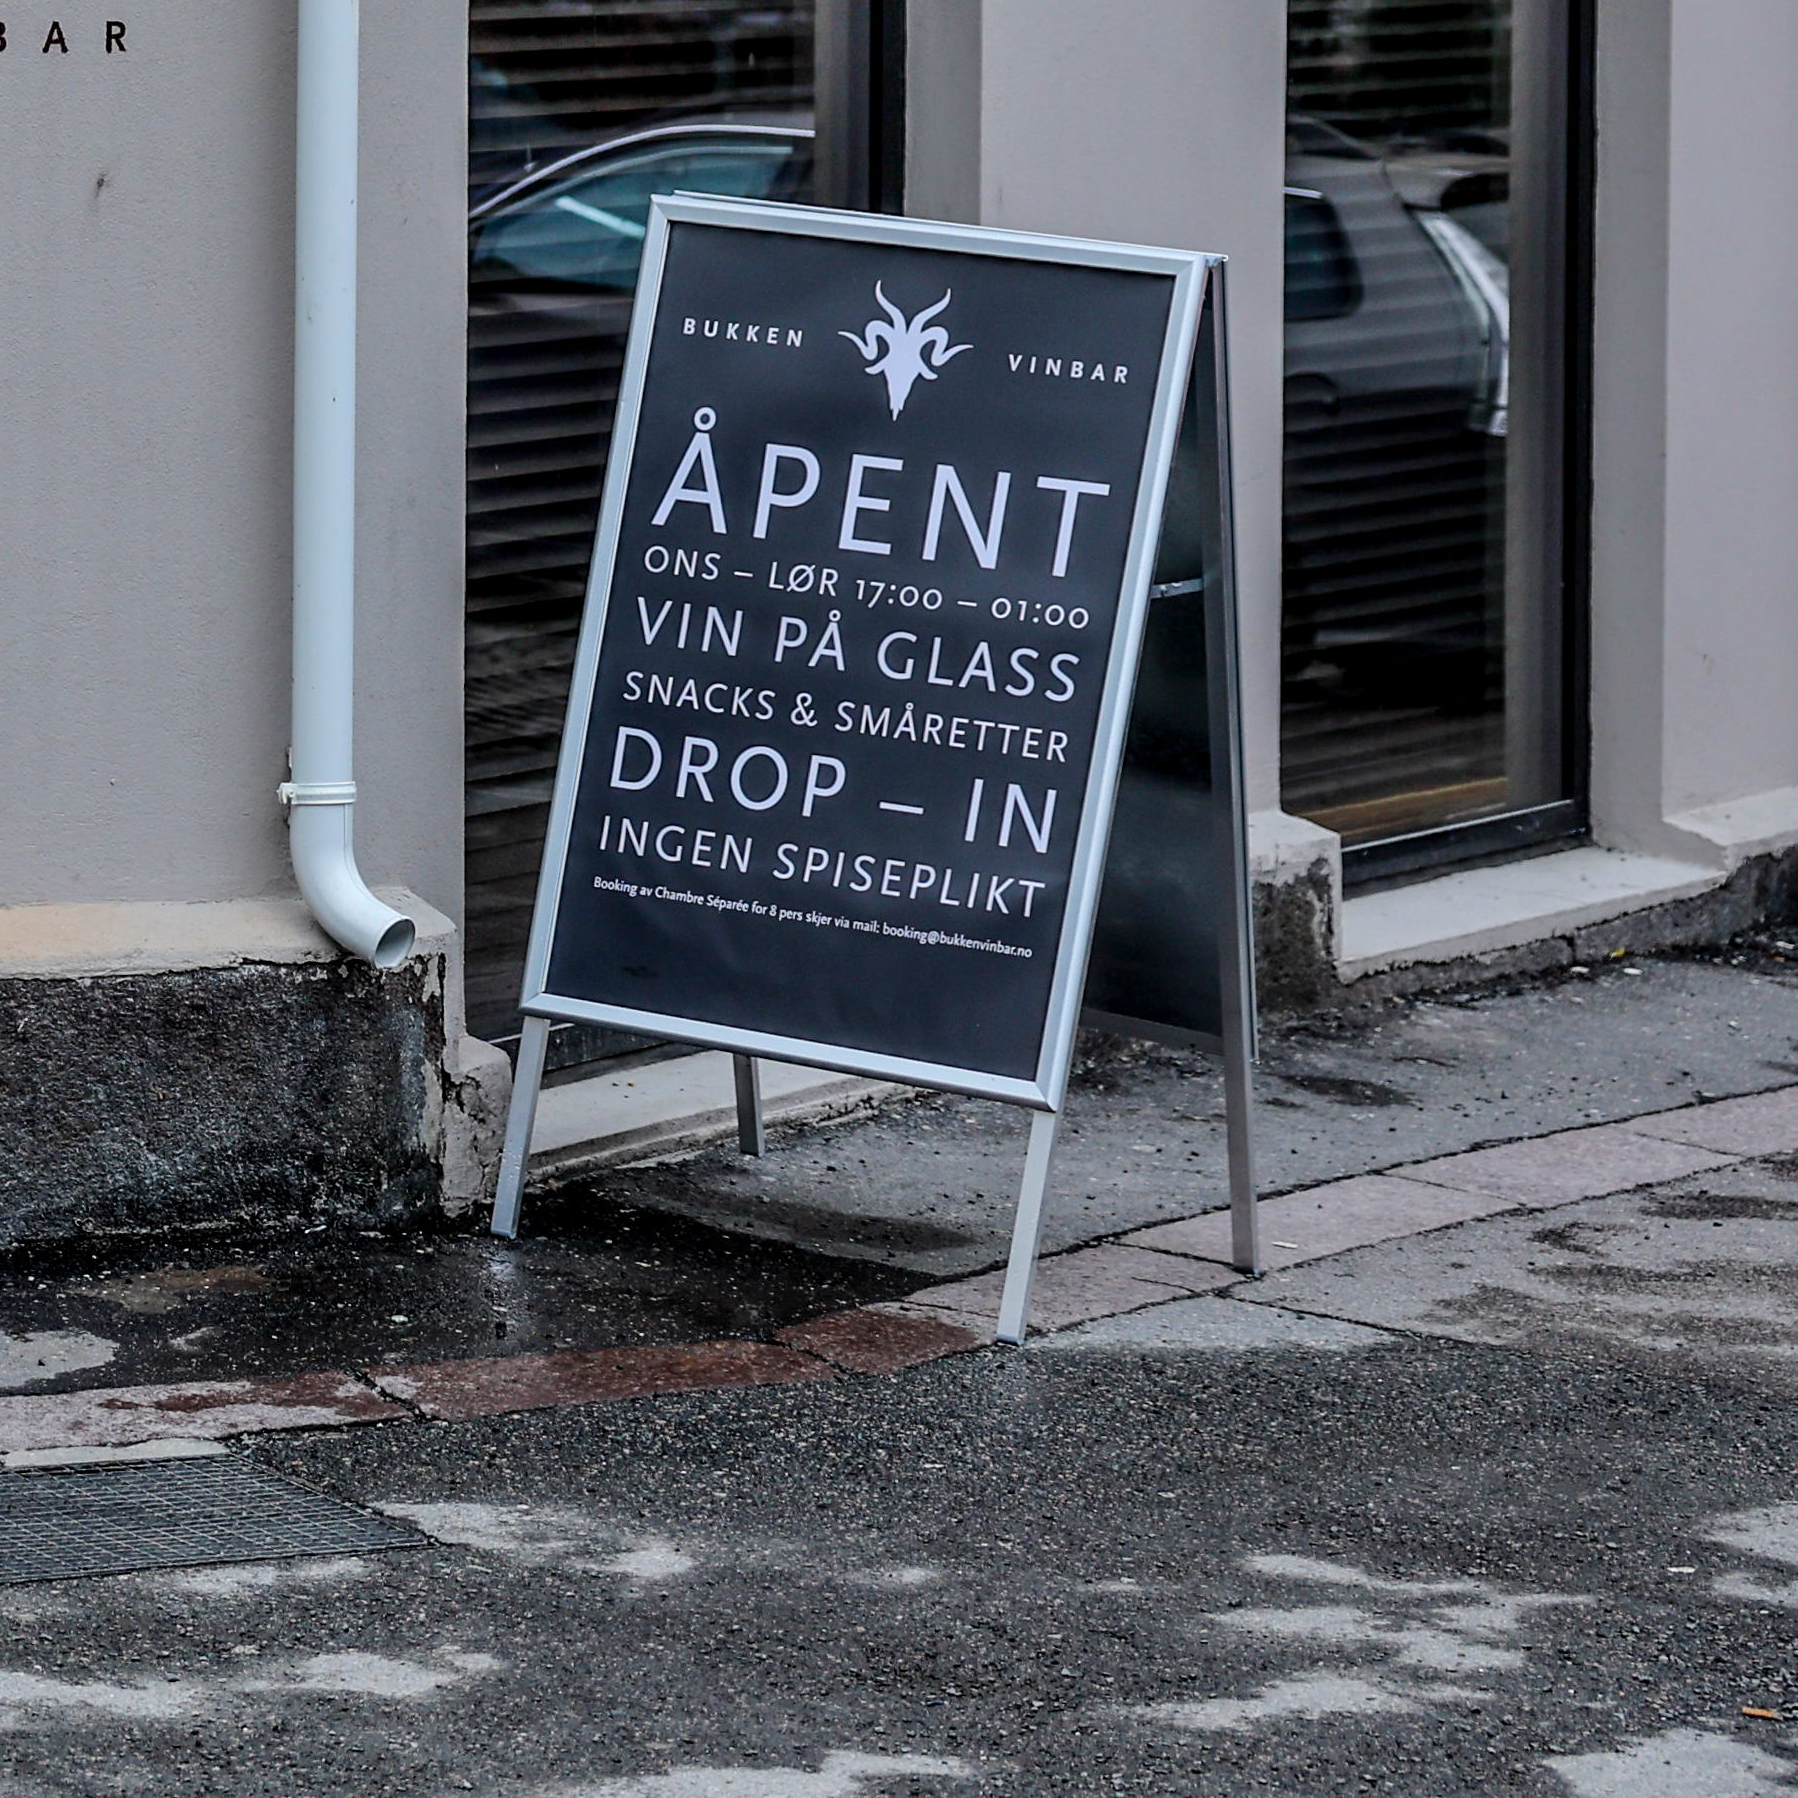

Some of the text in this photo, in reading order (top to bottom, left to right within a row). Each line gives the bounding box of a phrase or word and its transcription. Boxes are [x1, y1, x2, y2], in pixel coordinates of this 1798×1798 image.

[683, 317, 1129, 384] BUKKEN VINBAR
[651, 406, 1111, 578] ÅPENT
[644, 545, 721, 580] ONS
[768, 561, 839, 597] LØR
[856, 579, 943, 610] 17:00
[991, 597, 1089, 629] 01:00
[637, 596, 1080, 702] VIN PÅ GLASS
[623, 671, 1068, 763] SNACKS & SMÅRETTER
[610, 725, 846, 817] DROP
[964, 778, 1057, 854] IN
[599, 815, 1046, 918] INGEN SPISEPLIKT
[593, 876, 1033, 959] Booking av Chambre Séparée for 8 pers skjer via mail: booking@bukkenvinbar.no
